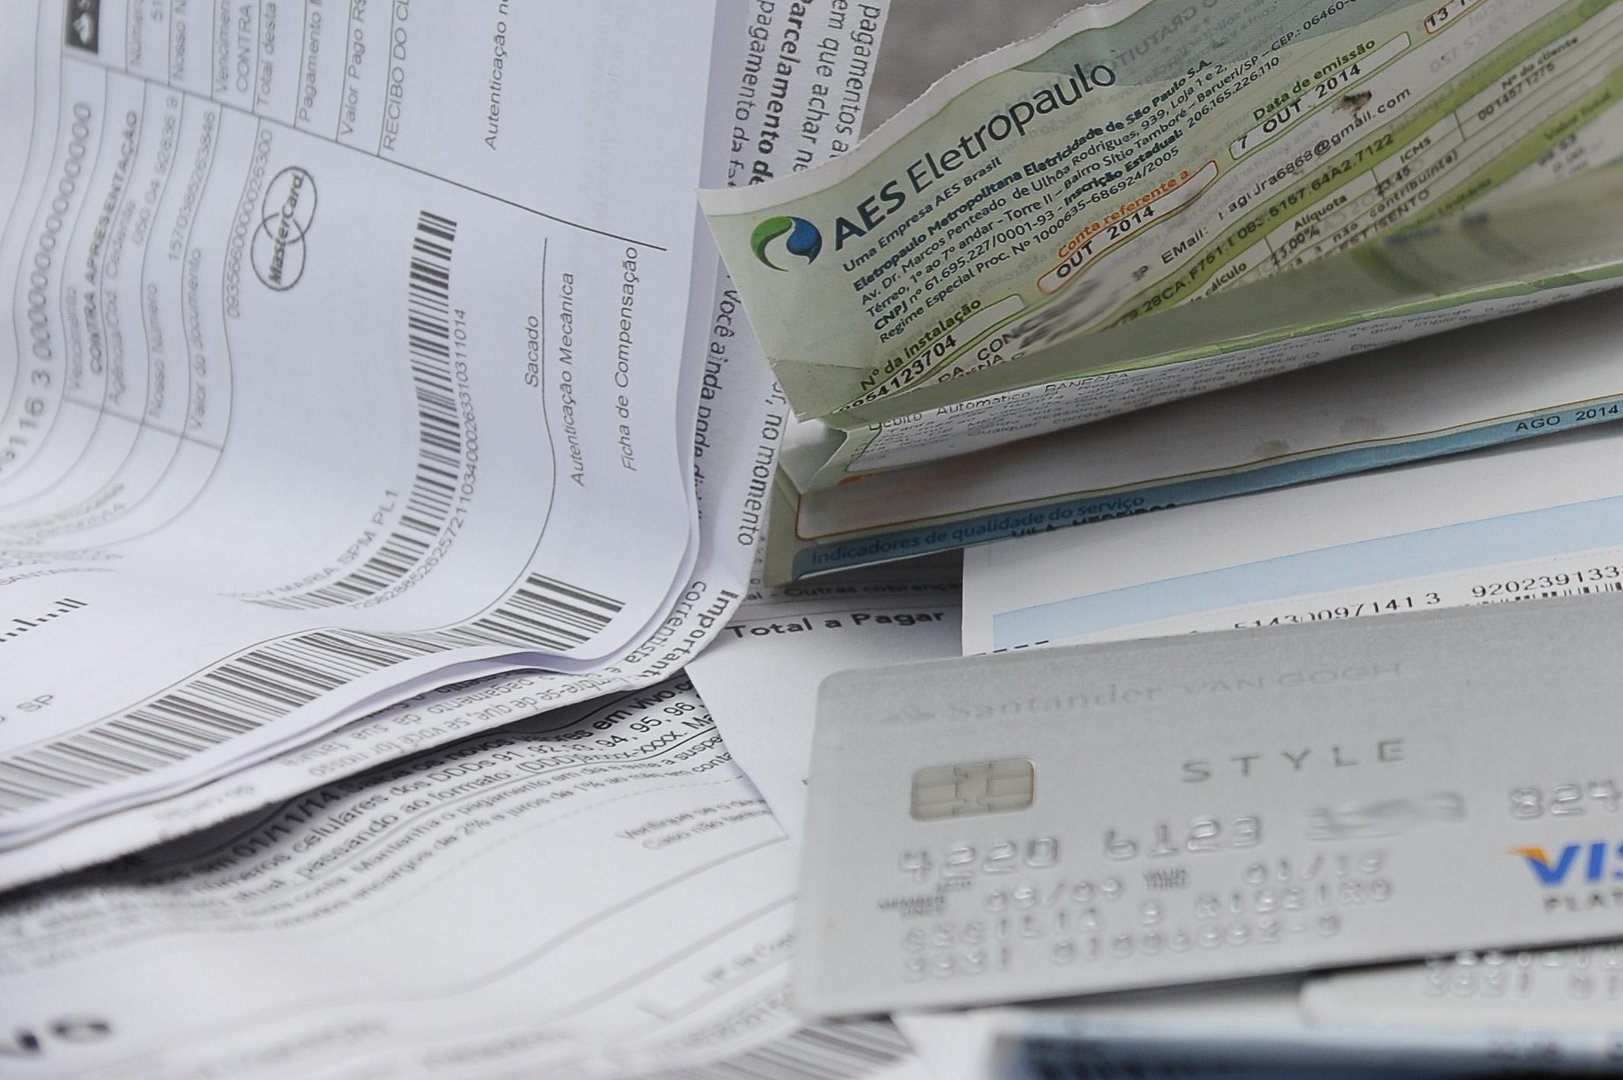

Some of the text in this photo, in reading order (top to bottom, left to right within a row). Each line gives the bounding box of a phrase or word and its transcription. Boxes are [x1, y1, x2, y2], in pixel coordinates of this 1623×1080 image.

[236, 1, 252, 94] CONTRA
[263, 1, 277, 55] desta
[348, 27, 366, 81] Pago
[393, 26, 408, 61] DO
[817, 37, 839, 78] que
[1429, 7, 1451, 27] 13
[256, 56, 273, 108] Total
[299, 11, 324, 123] Pagamento
[484, 20, 508, 151] Autenticação
[836, 4, 881, 136] pagamentos
[1252, 38, 1376, 121] Data emissão
[1262, 63, 1362, 134] OUT 2014
[341, 84, 359, 136] Valor
[383, 65, 405, 152] RECIBO
[731, 126, 750, 153] da
[801, 84, 830, 147] achar
[834, 180, 906, 251] AES
[906, 63, 1116, 194] Eletropaulo
[853, 77, 1186, 292] Eletropaulo Metropolitana Eletricidade São Paulo
[865, 282, 911, 318] Térreo,
[958, 224, 996, 252] andar
[1004, 196, 1042, 223] Torre
[1063, 161, 1100, 190] Bairro
[1102, 143, 1134, 165] Sítio
[1133, 109, 1188, 149] Tamboré
[1196, 55, 1259, 108] Barueri/SP
[901, 86, 1195, 273] Marcos Penteado Ulhôa Rodrigues, 939, Loja
[1399, 136, 1432, 163] ICMS
[268, 174, 305, 286] MasterCard
[843, 157, 1002, 273] Uma Empresa AES Brasil
[873, 304, 909, 331] CNPJ
[924, 208, 1056, 292] 61.695.227/0001-93
[1064, 170, 1123, 206] Inscrição
[1124, 130, 1184, 172] Estadual:
[1055, 206, 1155, 279] OUT 2014
[1057, 178, 1177, 259] Conta referente
[879, 307, 925, 344] Regime
[925, 270, 976, 308] Especial
[976, 250, 1010, 274] Proc.
[903, 298, 982, 360] instalação
[524, 314, 540, 389] Sacado
[558, 271, 586, 487] Autenticação Mecânica
[613, 246, 639, 472] Ficha de Compensação
[701, 288, 742, 401] Você ainda
[1515, 403, 1620, 433] AGO 2014
[736, 413, 783, 547] no momento
[812, 534, 920, 566] Indicadores
[925, 530, 948, 545] de
[952, 513, 1045, 542] qualidade
[1049, 507, 1073, 522] do
[1077, 495, 1145, 517] serviço
[623, 579, 708, 666] correntista
[725, 609, 946, 640] Total Pagar
[948, 682, 1169, 721] Santander
[1180, 737, 1407, 784] STYLE
